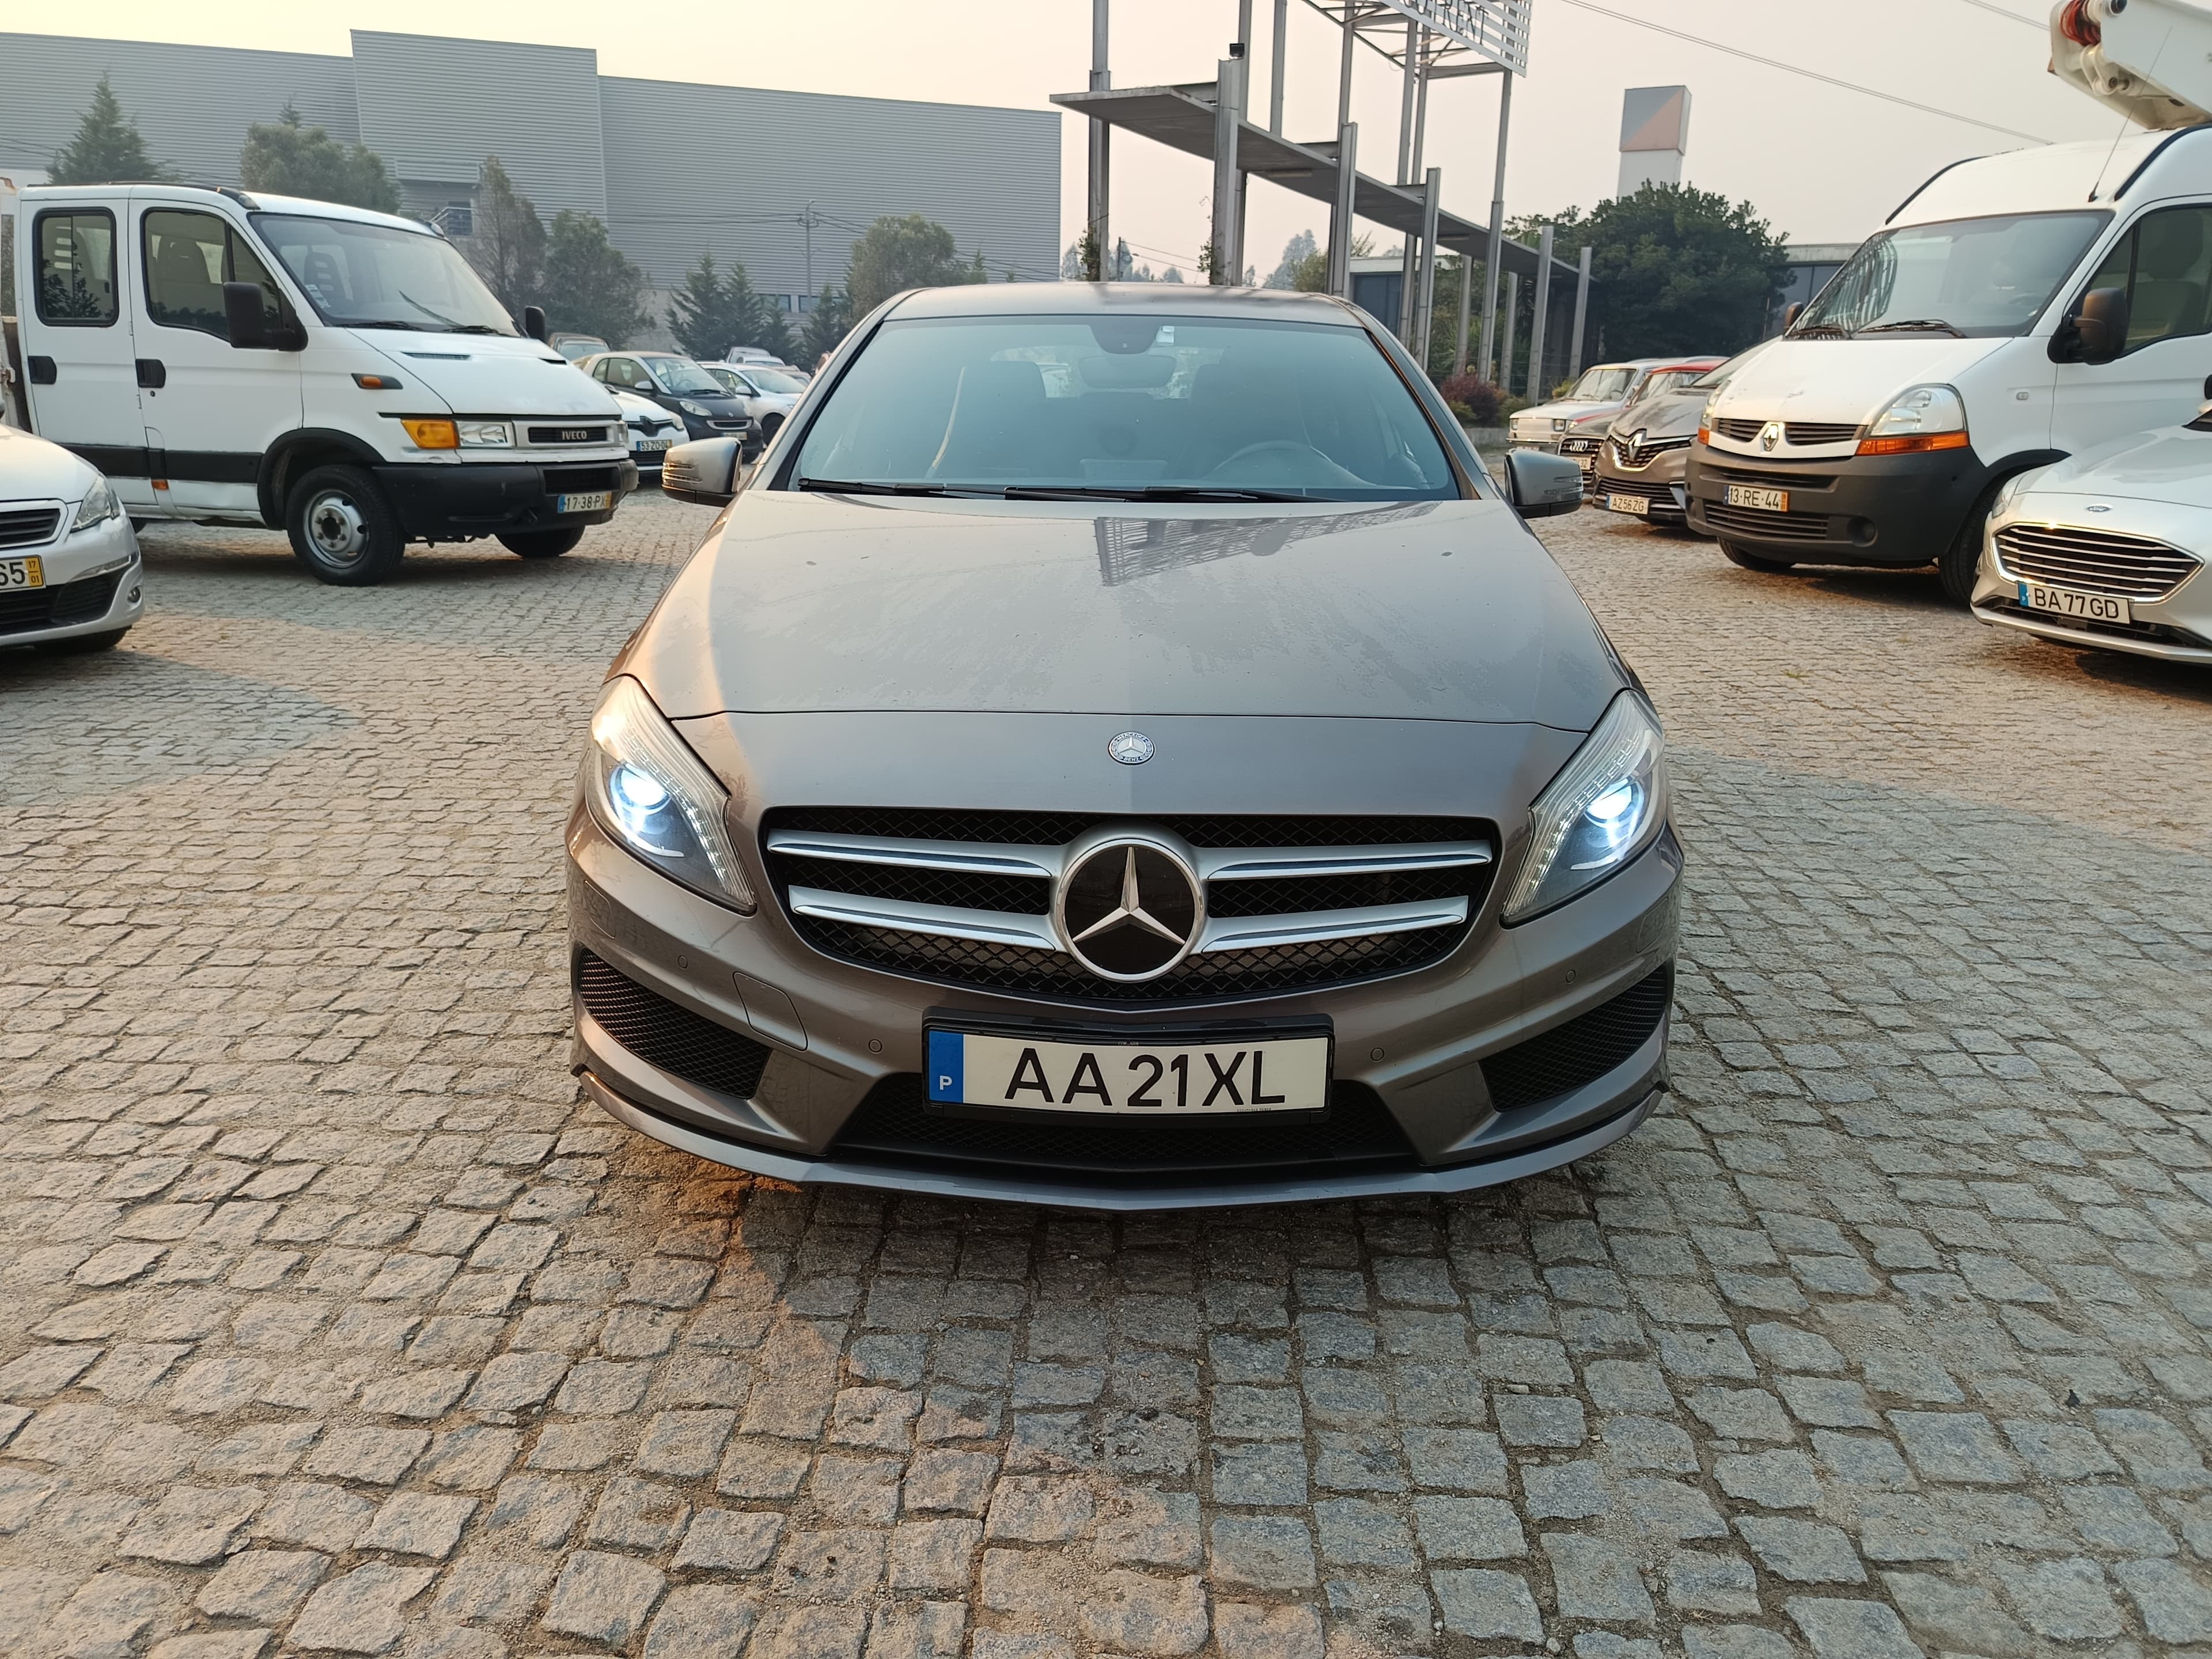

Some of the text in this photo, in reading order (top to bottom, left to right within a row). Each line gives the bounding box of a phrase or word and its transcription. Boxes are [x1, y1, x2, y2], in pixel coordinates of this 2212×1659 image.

[562, 430, 587, 440] IVECO
[31, 575, 39, 583] 01
[939, 1075, 952, 1090] P
